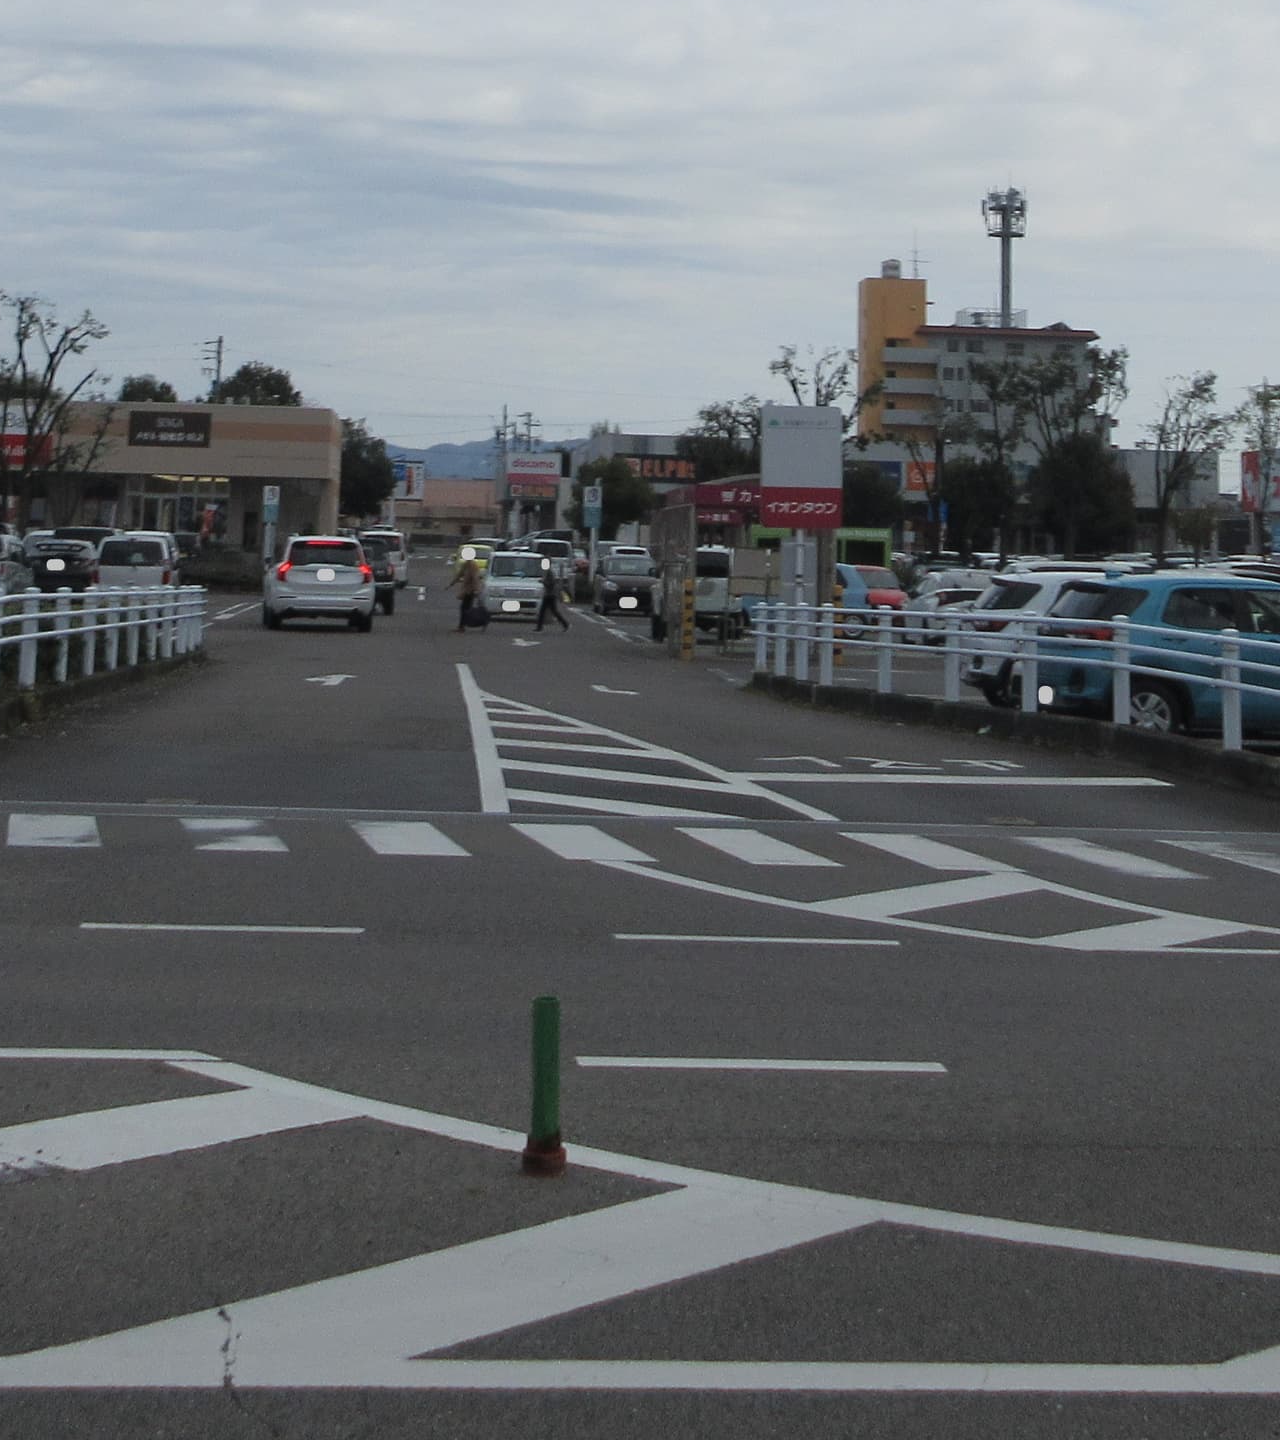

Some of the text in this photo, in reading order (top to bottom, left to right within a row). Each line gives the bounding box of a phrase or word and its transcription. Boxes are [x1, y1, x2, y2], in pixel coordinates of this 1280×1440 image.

[512, 459, 555, 469] docomo
[767, 501, 838, 515] イオンタウン
